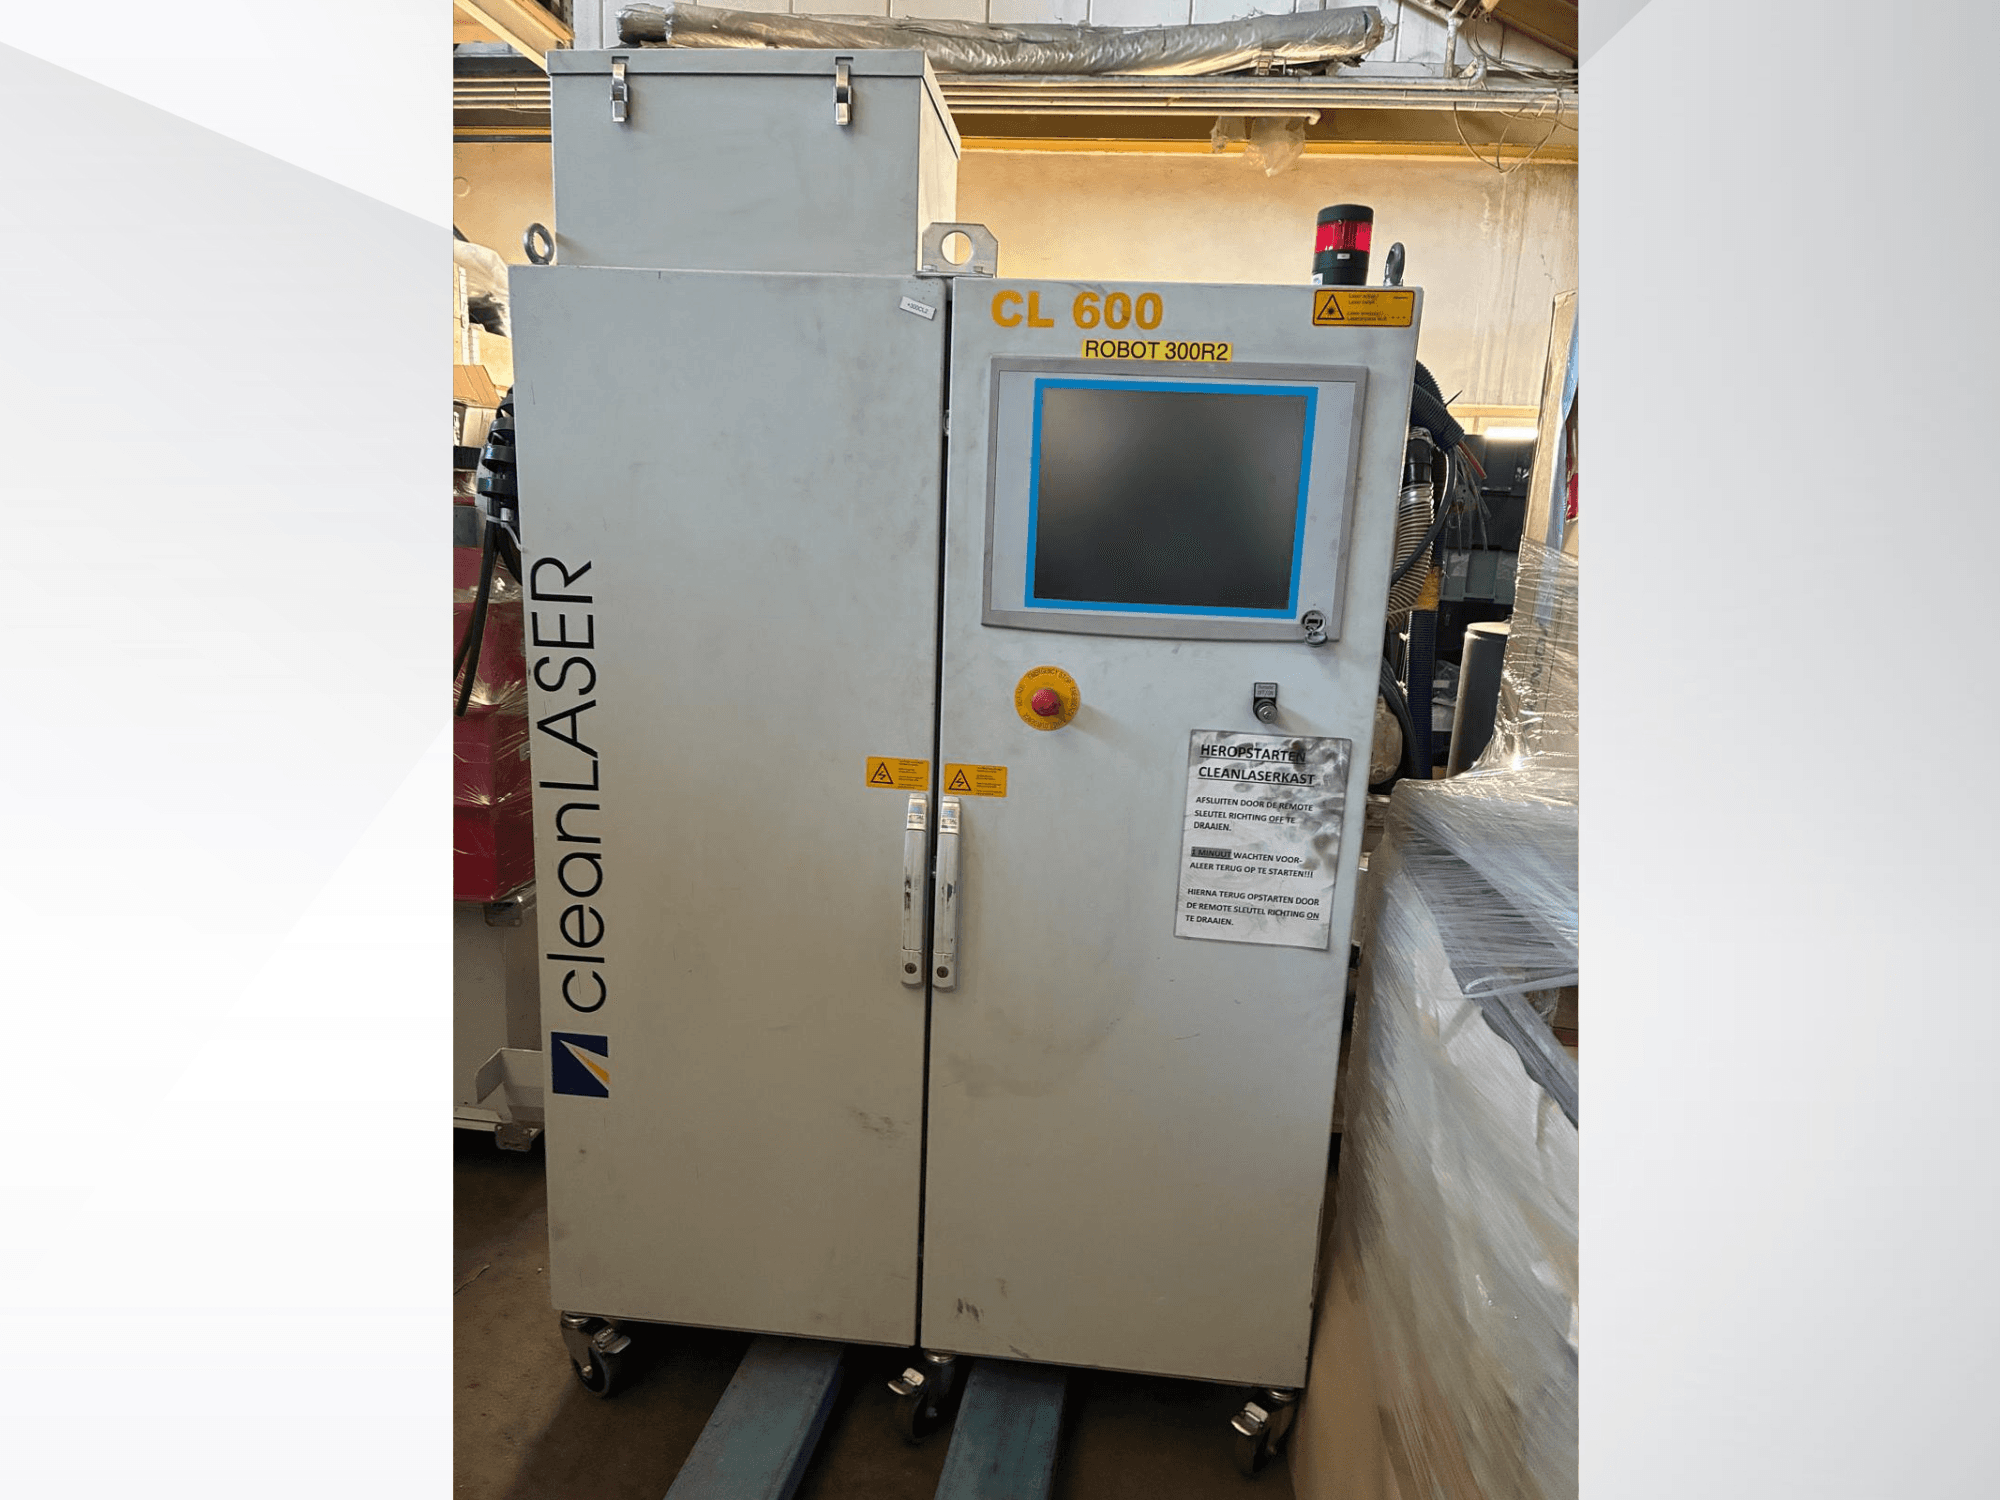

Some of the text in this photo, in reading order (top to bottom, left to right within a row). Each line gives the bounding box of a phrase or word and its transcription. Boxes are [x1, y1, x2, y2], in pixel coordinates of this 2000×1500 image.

[991, 289, 1164, 331] CL 600
[1085, 340, 1229, 361] ROBOT 300R2
[1200, 744, 1306, 763] HEROPSTARTEN
[1198, 766, 1315, 785] CLEANLASERKAST
[530, 557, 607, 1013] cleanLASER
[1195, 796, 1314, 812] AFSLUITEN DOOR DE REMOTE
[1194, 809, 1296, 824] SLEUTEL RICHTING OFF TE
[1193, 821, 1232, 832] DRAAIEN.
[1197, 848, 1232, 859] MINUUT
[1233, 852, 1274, 862] WACHTEN
[1275, 855, 1303, 864] VOOR-
[1190, 862, 1214, 870] ALEER
[1216, 863, 1243, 873] TERUG
[1257, 867, 1267, 875] TE
[1268, 868, 1313, 879] STARTEN!!!
[1187, 888, 1320, 906] HIERNA TERUG OPSTARTEN DOOR
[1186, 901, 1320, 920] DE REMOTE SLEUTEL RICHTING ON
[1185, 914, 1234, 926] TE DRAAIEN.
